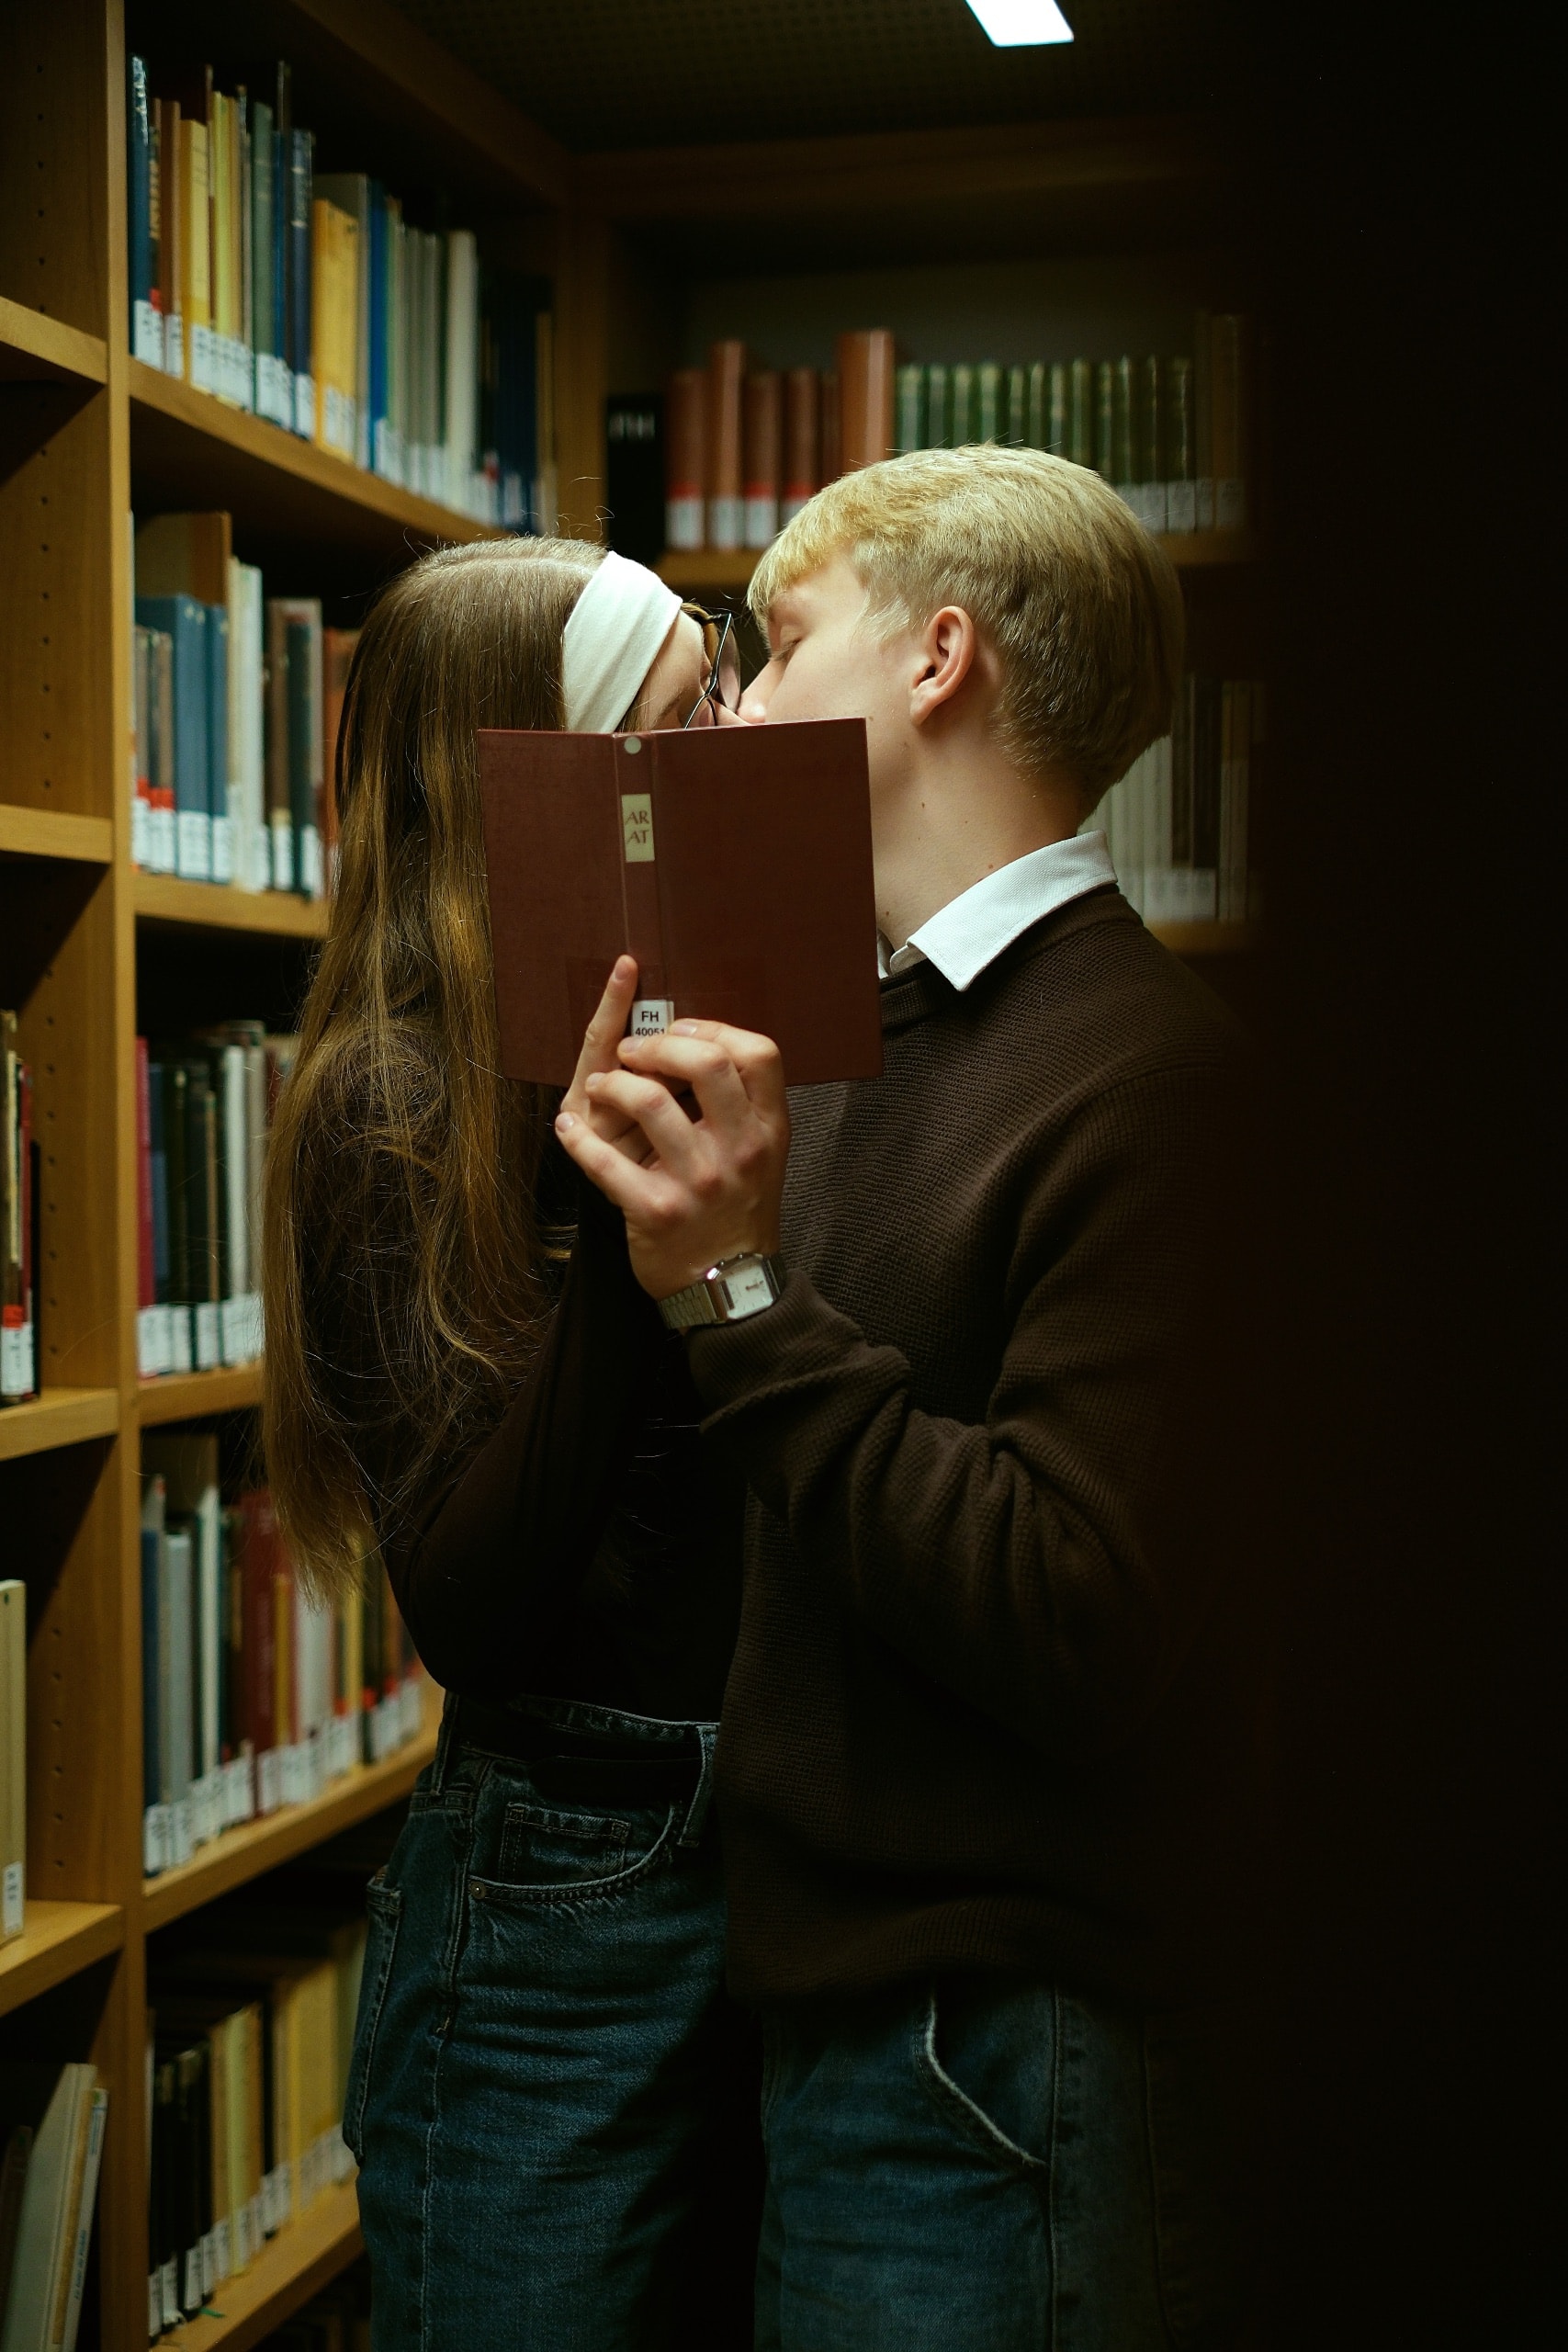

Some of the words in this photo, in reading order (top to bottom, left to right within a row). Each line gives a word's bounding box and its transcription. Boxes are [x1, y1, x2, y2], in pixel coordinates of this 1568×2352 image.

[626, 810, 649, 825] AR
[626, 830, 649, 843] AT
[641, 1011, 660, 1022] FH
